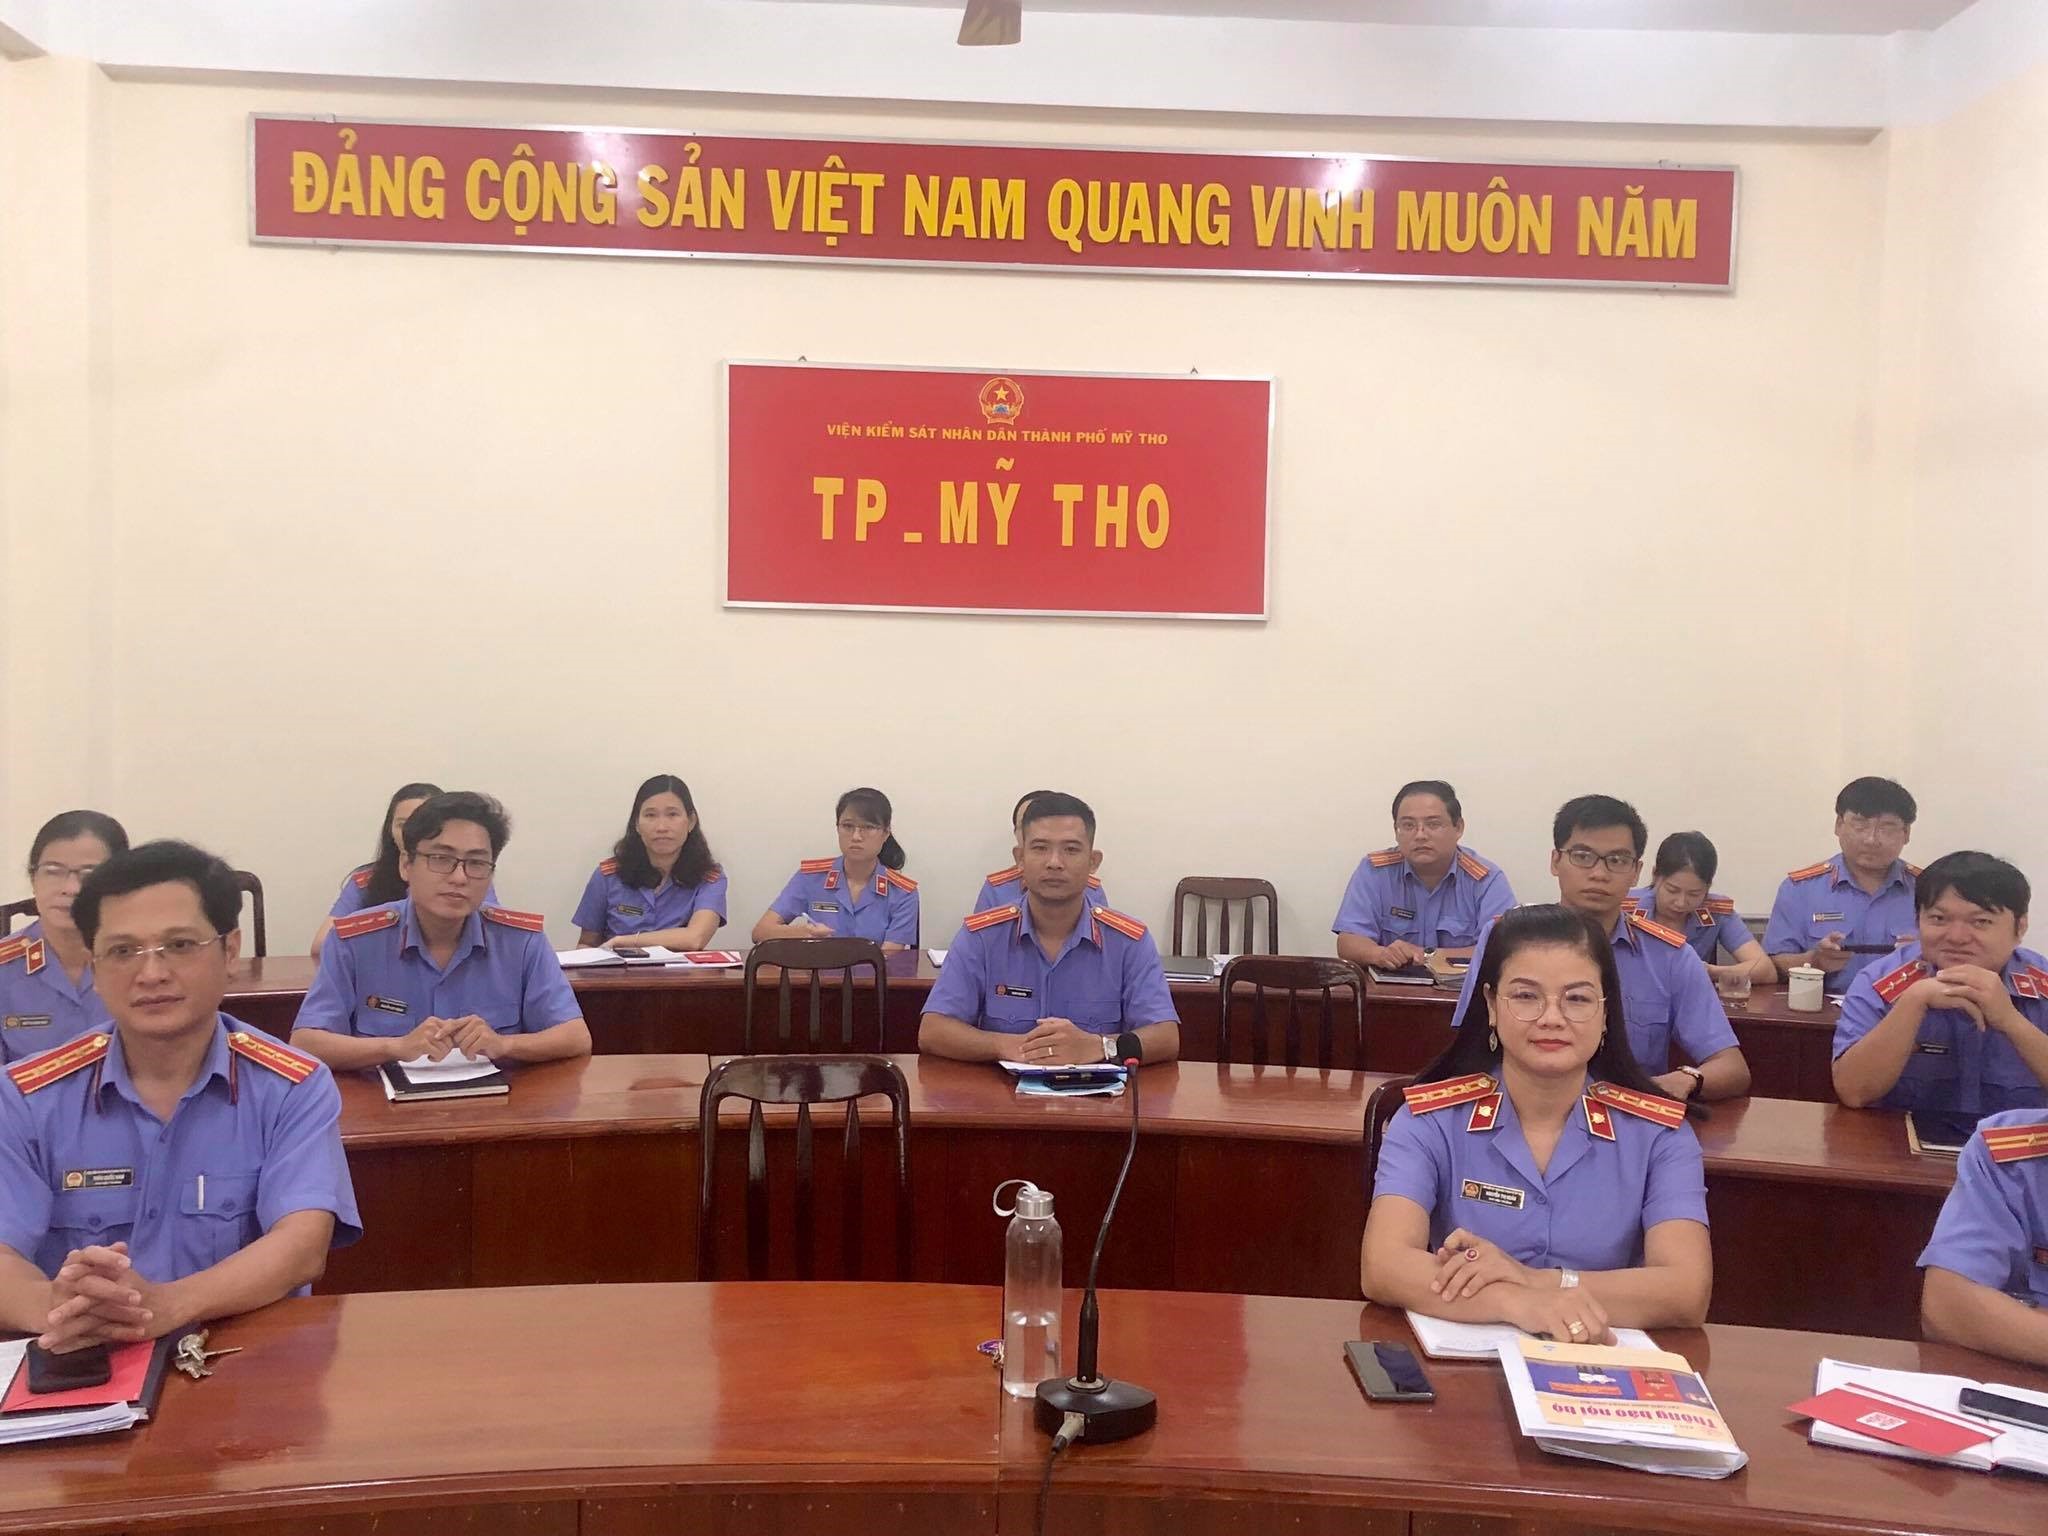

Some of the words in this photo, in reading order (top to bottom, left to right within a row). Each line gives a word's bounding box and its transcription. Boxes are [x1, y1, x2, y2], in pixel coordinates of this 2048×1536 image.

[290, 128, 446, 220] ĐẢNG
[465, 143, 618, 236] CỘNG
[636, 143, 747, 230] SẢN
[766, 155, 886, 247] VIỆT
[902, 173, 1028, 240] NAM
[1047, 178, 1231, 254] QUANG
[1250, 184, 1375, 250] VINH
[1396, 176, 1553, 256] MUÔN
[1577, 186, 1698, 260] NĂM
[827, 421, 862, 438] VIỆN
[866, 420, 904, 438] KIỂM
[909, 424, 937, 439] SÁT
[942, 426, 982, 440] NHÂN
[987, 427, 1018, 442] DÂN
[1022, 428, 1072, 443] THÀNH
[1076, 426, 1107, 444] PHỐ
[1111, 430, 1133, 444] MỸ
[1138, 433, 1168, 445] THO
[1053, 483, 1170, 549] THO
